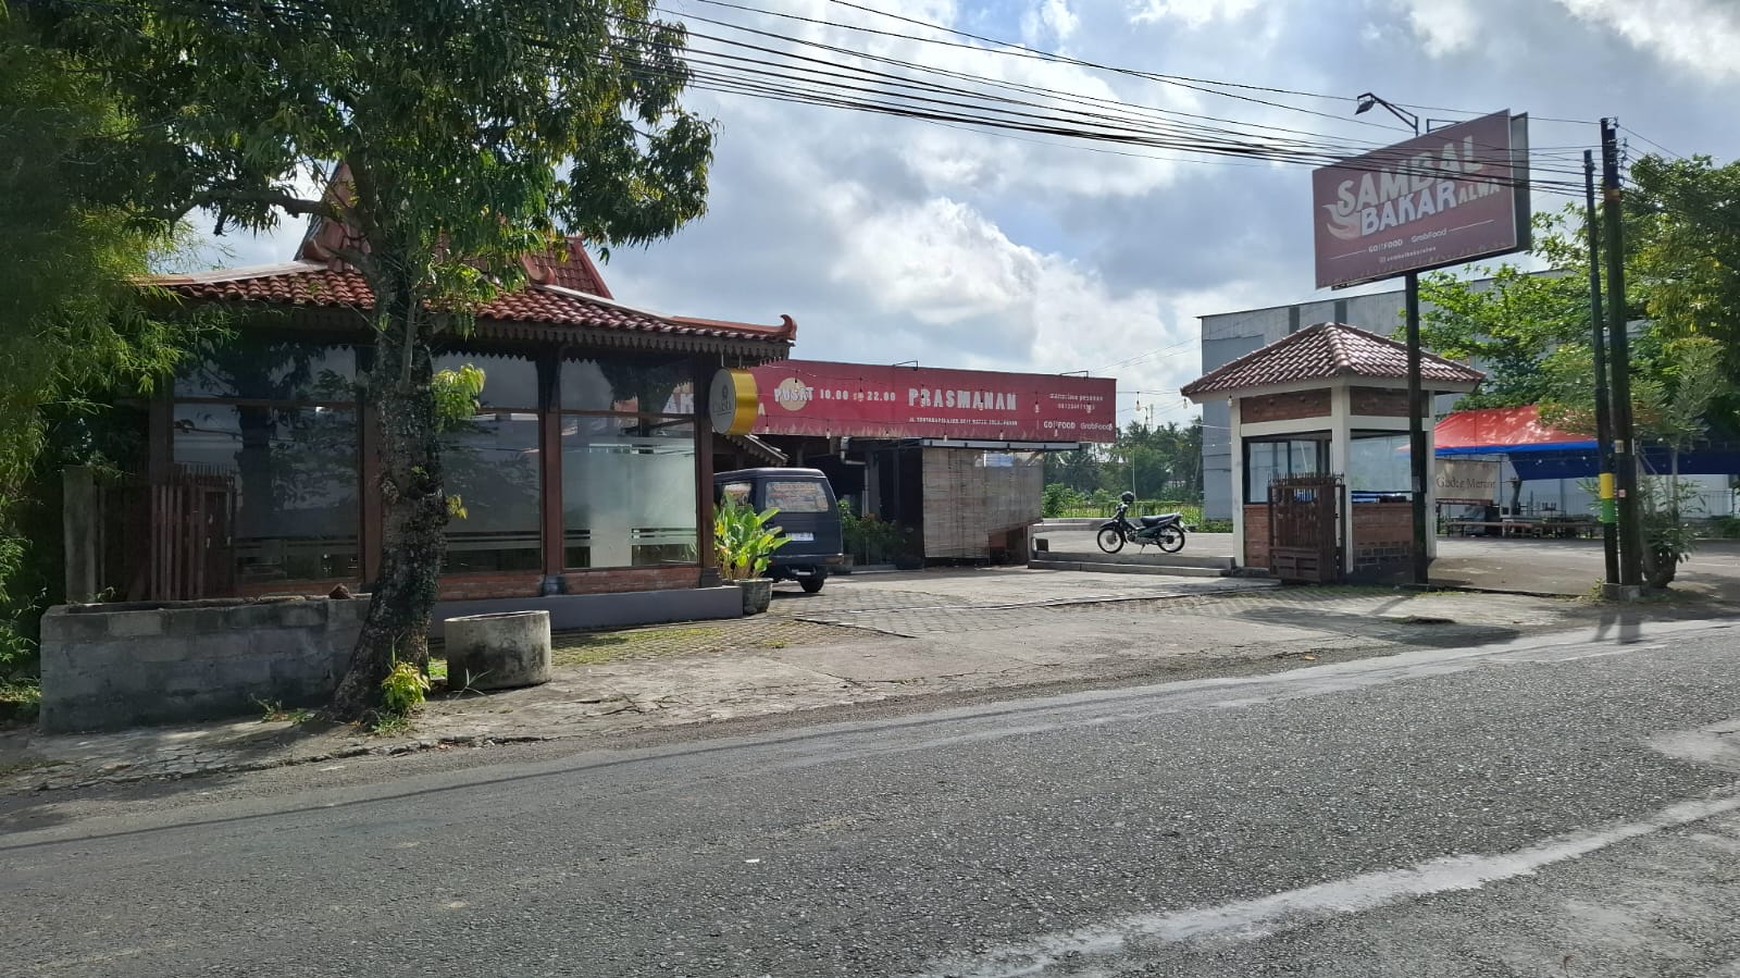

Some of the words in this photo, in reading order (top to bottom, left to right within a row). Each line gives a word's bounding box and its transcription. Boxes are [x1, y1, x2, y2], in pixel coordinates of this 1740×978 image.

[1337, 135, 1483, 216] SAMBAL
[1361, 180, 1457, 236] BAKAR
[1458, 177, 1501, 204] ALWA
[774, 386, 815, 402] PUSAT
[820, 388, 850, 401] 10.00
[867, 391, 896, 402] 22.00
[908, 389, 1017, 411] PRASMANAN
